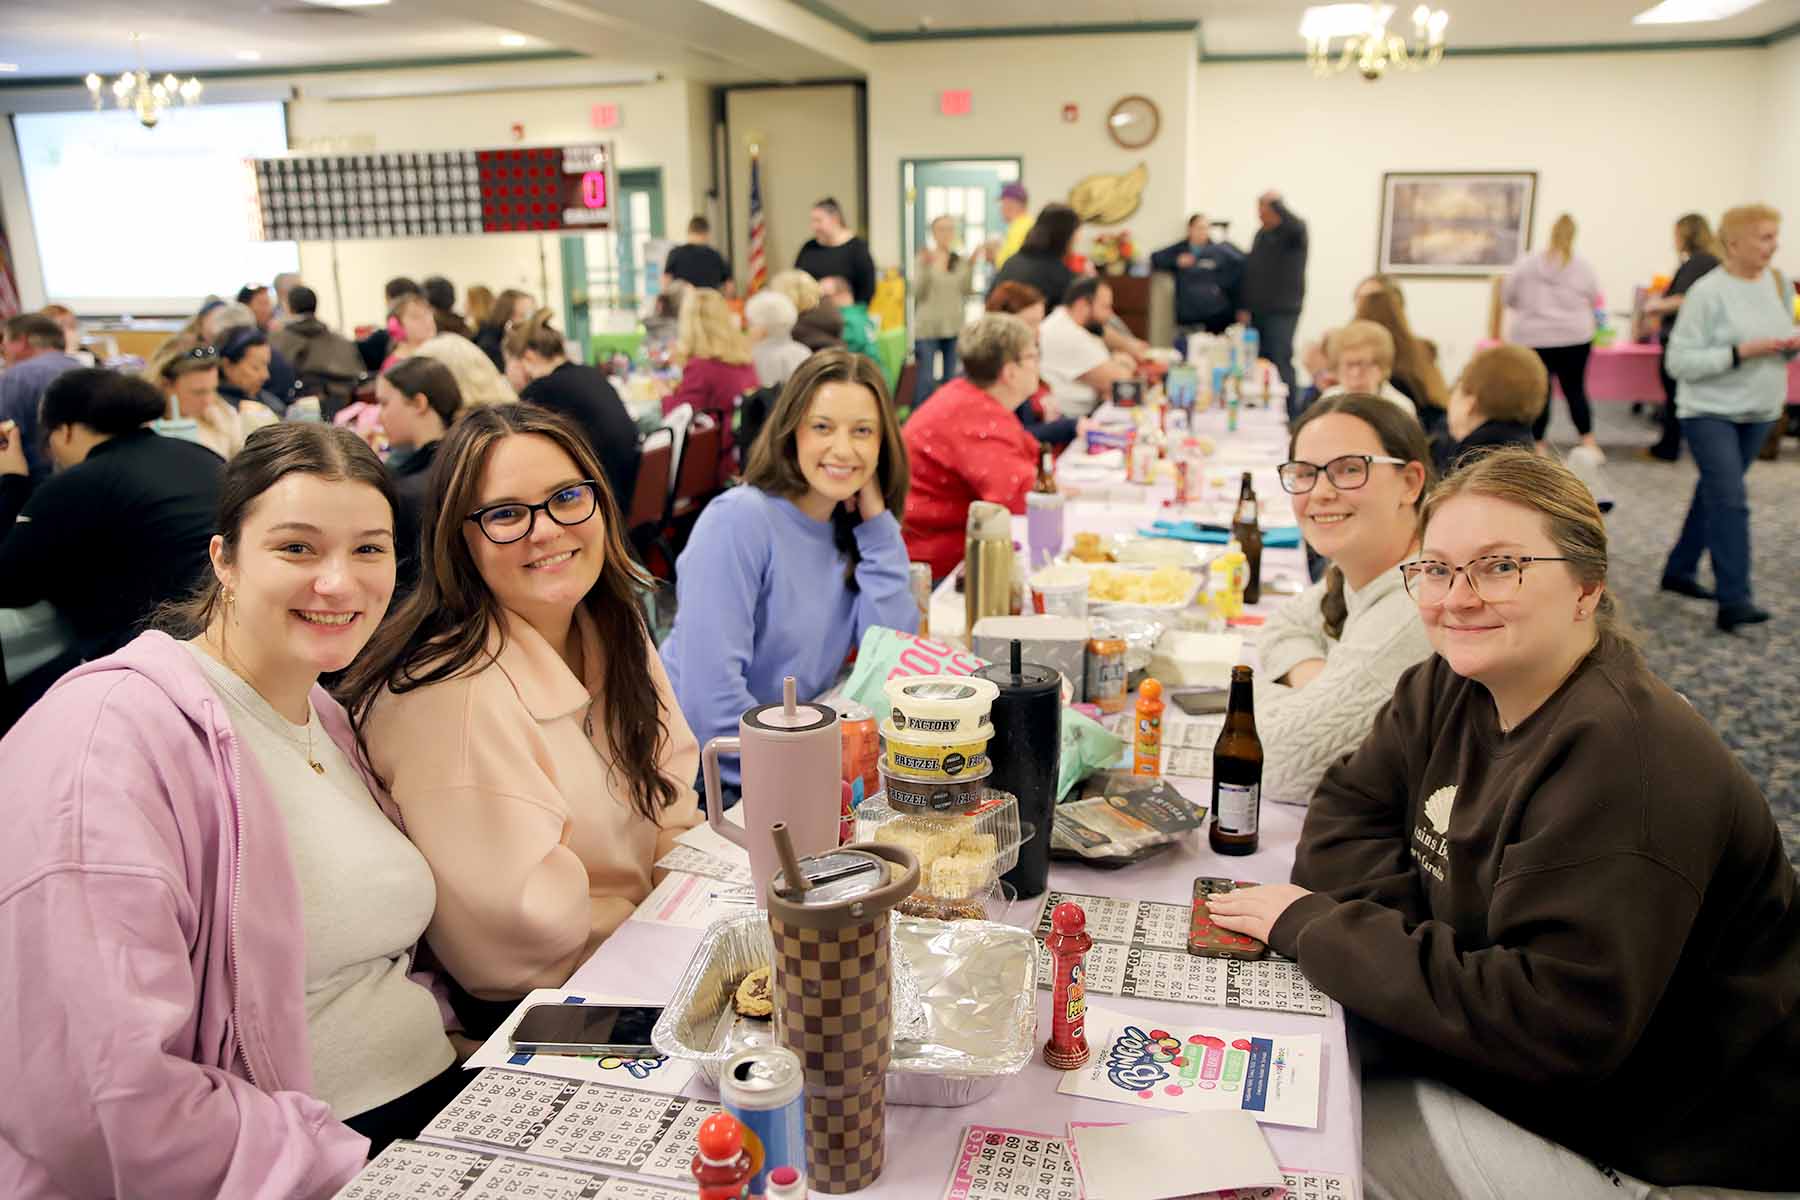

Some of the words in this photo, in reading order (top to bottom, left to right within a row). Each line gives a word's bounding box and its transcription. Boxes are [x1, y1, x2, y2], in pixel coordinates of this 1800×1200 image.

[908, 718, 958, 731] FACTORY
[896, 753, 939, 770] PRETZEL
[471, 1081, 488, 1091] 23
[515, 1076, 530, 1085] 13
[549, 1082, 563, 1090] 11
[487, 1084, 504, 1094] 28
[504, 1086, 520, 1097] 26
[520, 1089, 537, 1100] 30
[603, 1090, 617, 1098] 11
[459, 1093, 475, 1104] 40
[477, 1096, 491, 1106] 41
[538, 1094, 553, 1103] 19
[619, 1093, 634, 1102] 13
[653, 1098, 669, 1107] 15
[510, 1102, 526, 1113] 33
[526, 1105, 543, 1116] 38
[575, 1100, 589, 1110] 18
[592, 1101, 608, 1112] 25
[609, 1105, 624, 1115] 16
[447, 1106, 464, 1116] 50
[464, 1109, 481, 1120] 56
[626, 1106, 642, 1117] 24
[644, 1109, 660, 1120] 22
[481, 1113, 496, 1122] 49
[499, 1115, 514, 1126] 47
[563, 1112, 579, 1122] 43
[581, 1114, 598, 1125] 36
[434, 1118, 452, 1129] 63
[451, 1121, 468, 1132] 68
[514, 1118, 531, 1129] 48
[617, 1120, 632, 1130] 41
[634, 1122, 651, 1134] 38
[468, 1124, 485, 1135] 69
[485, 1127, 503, 1139] 65
[554, 1124, 568, 1136] 47
[570, 1127, 587, 1138] 58
[674, 1130, 690, 1140] 36
[503, 1131, 520, 1142] 66
[588, 1130, 605, 1141] 60
[607, 1133, 623, 1143] 51
[542, 1138, 558, 1148] 61
[559, 1141, 577, 1152] 70
[624, 1136, 640, 1147] 48
[1005, 1136, 1020, 1148] 69
[1025, 1140, 1040, 1152] 64
[578, 1144, 595, 1154] 71
[595, 1146, 612, 1158] 65
[981, 1147, 996, 1160] 48
[1045, 1142, 1060, 1154] 72
[613, 1148, 630, 1160] 64
[1001, 1151, 1016, 1164] 50
[376, 1157, 394, 1168] 25
[393, 1159, 411, 1170] 24
[460, 1156, 476, 1165] 11
[1022, 1154, 1036, 1167] 47
[1042, 1157, 1056, 1170] 57
[411, 1164, 427, 1174] 19
[430, 1167, 445, 1178] 17
[976, 1164, 992, 1175] 34
[997, 1166, 1012, 1179] 32
[361, 1171, 380, 1181] 31
[378, 1173, 397, 1185] 35
[447, 1168, 464, 1182] 27
[1039, 1172, 1054, 1184] 40
[414, 1181, 431, 1193] 44
[972, 1178, 987, 1190] 30
[993, 1181, 1008, 1192] 22
[1060, 1176, 1074, 1187] 41
[1304, 1176, 1318, 1187] 74
[1326, 1179, 1340, 1190] 75
[346, 1185, 363, 1198] 49
[431, 1184, 449, 1197] 42
[1014, 1184, 1029, 1196] 29
